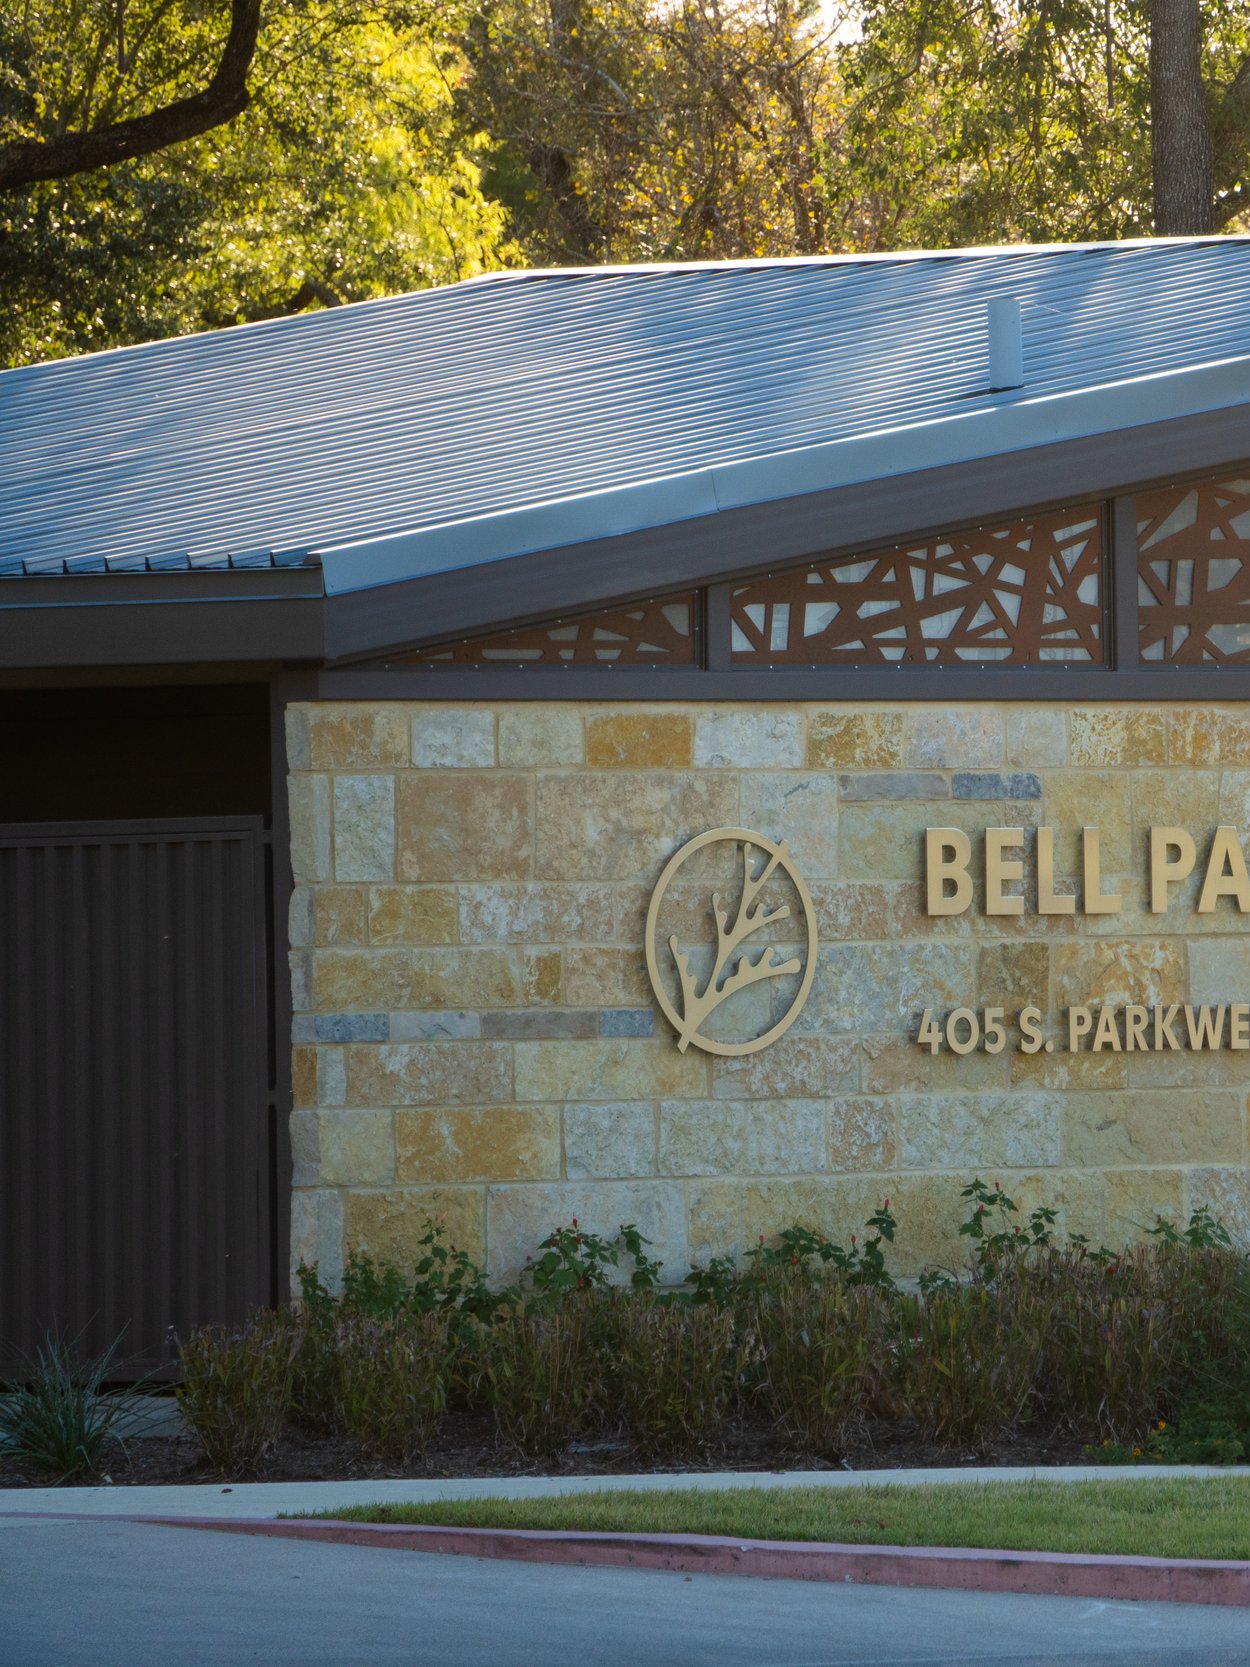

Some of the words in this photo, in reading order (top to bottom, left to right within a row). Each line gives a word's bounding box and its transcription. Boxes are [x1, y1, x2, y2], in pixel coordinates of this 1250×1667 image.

[925, 826, 1122, 917] BELL
[917, 1007, 1006, 1056] 405
[1019, 1007, 1054, 1055] S.
